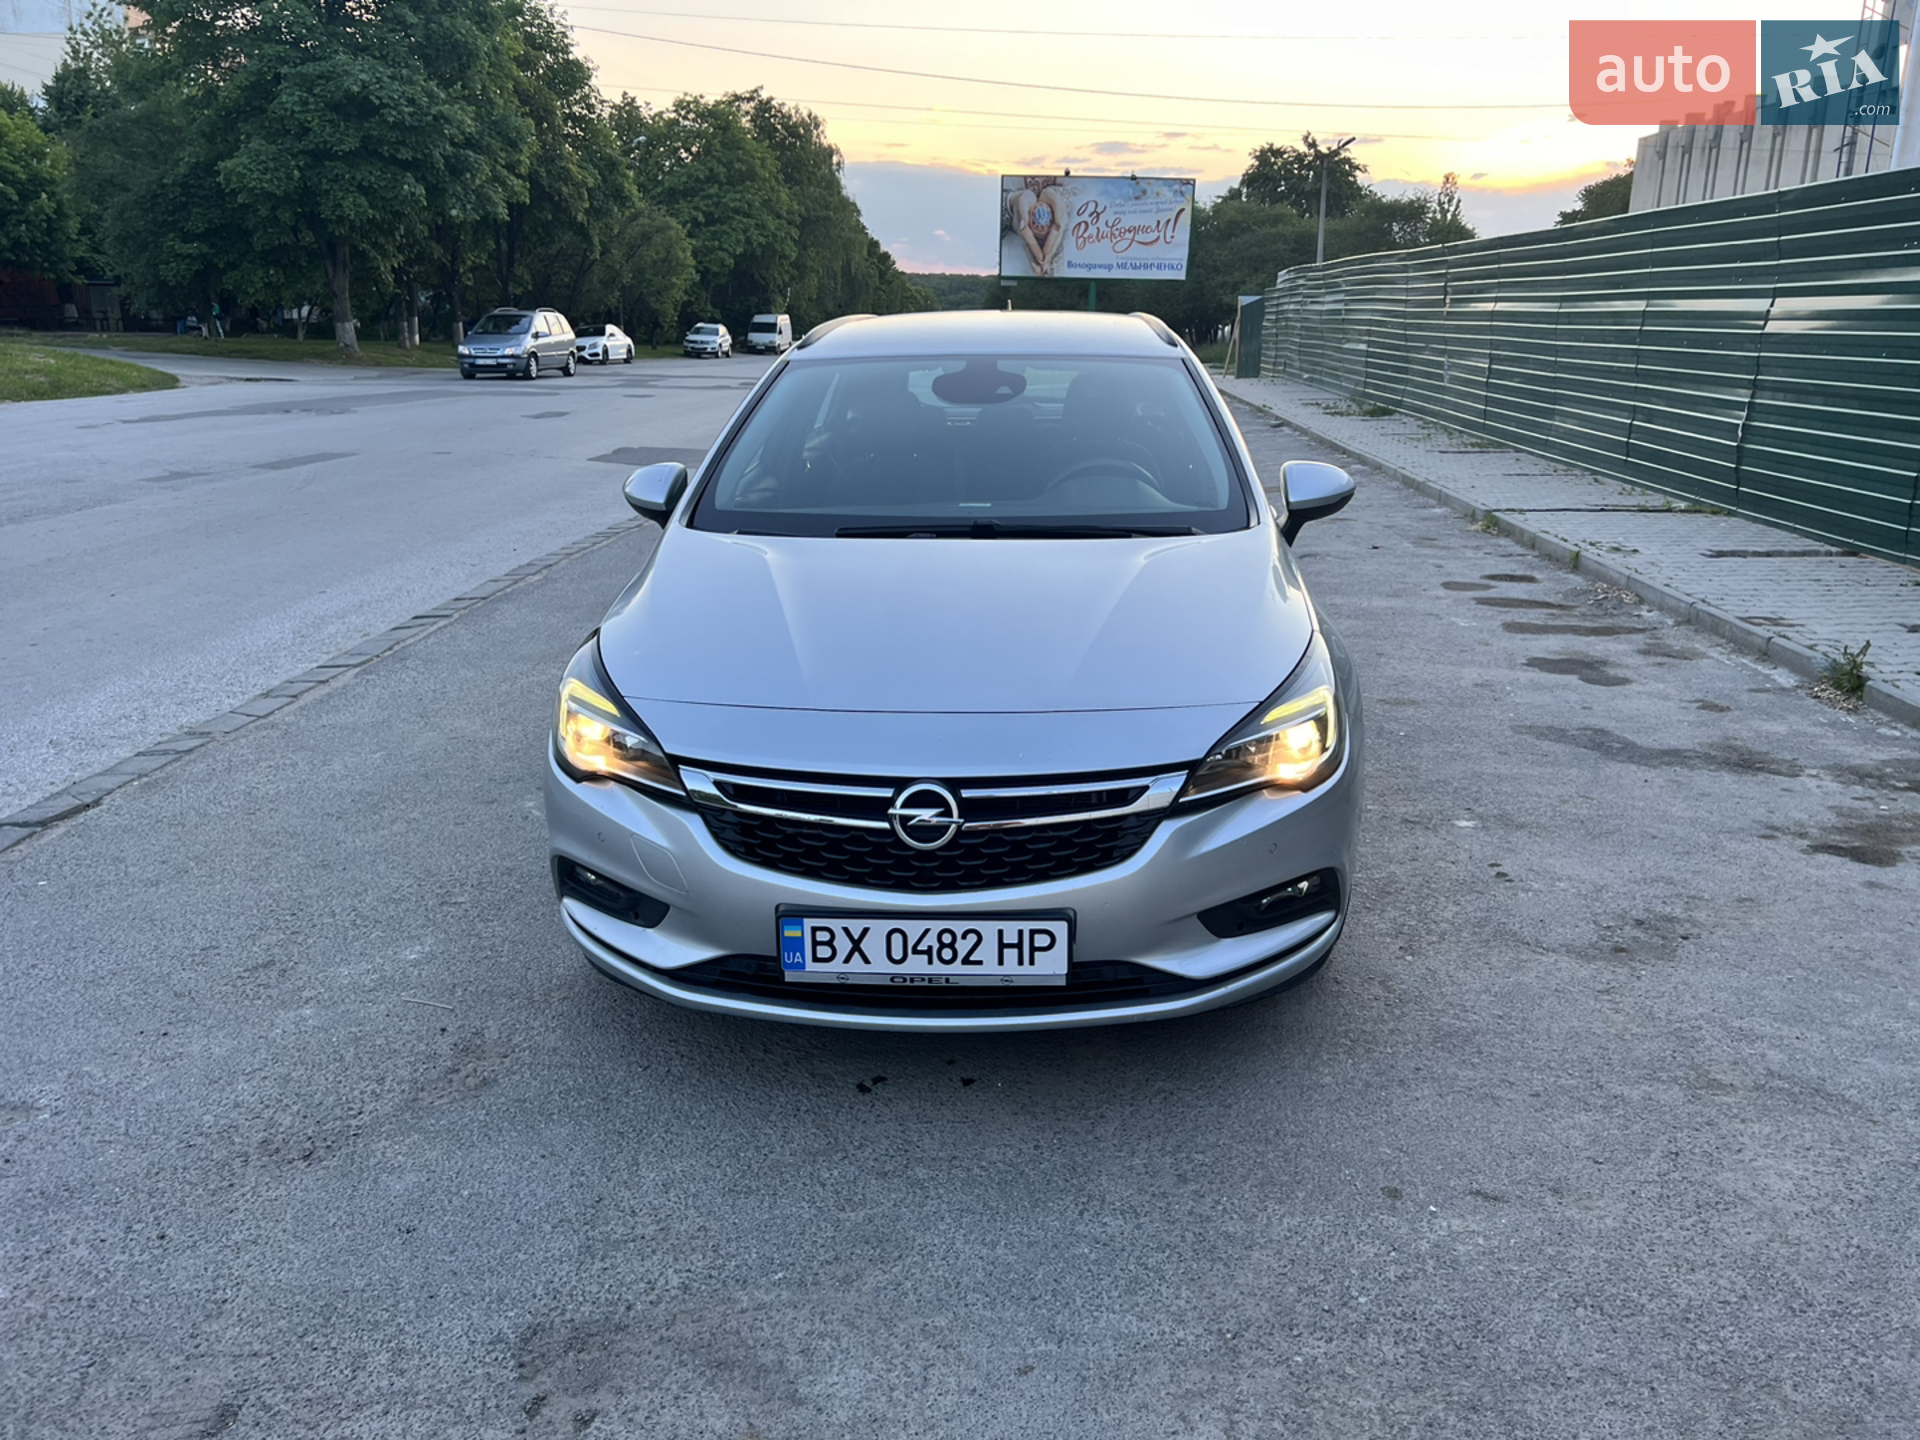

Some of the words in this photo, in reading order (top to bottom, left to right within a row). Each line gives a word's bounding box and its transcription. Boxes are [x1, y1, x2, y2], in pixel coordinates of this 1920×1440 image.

[1115, 261, 1184, 272] МЕЛЬНИЧЕНКО
[810, 926, 872, 965] BX
[886, 927, 984, 966] 0482
[997, 928, 1057, 966] HP
[784, 951, 803, 964] UA
[889, 976, 959, 985] OPEL
